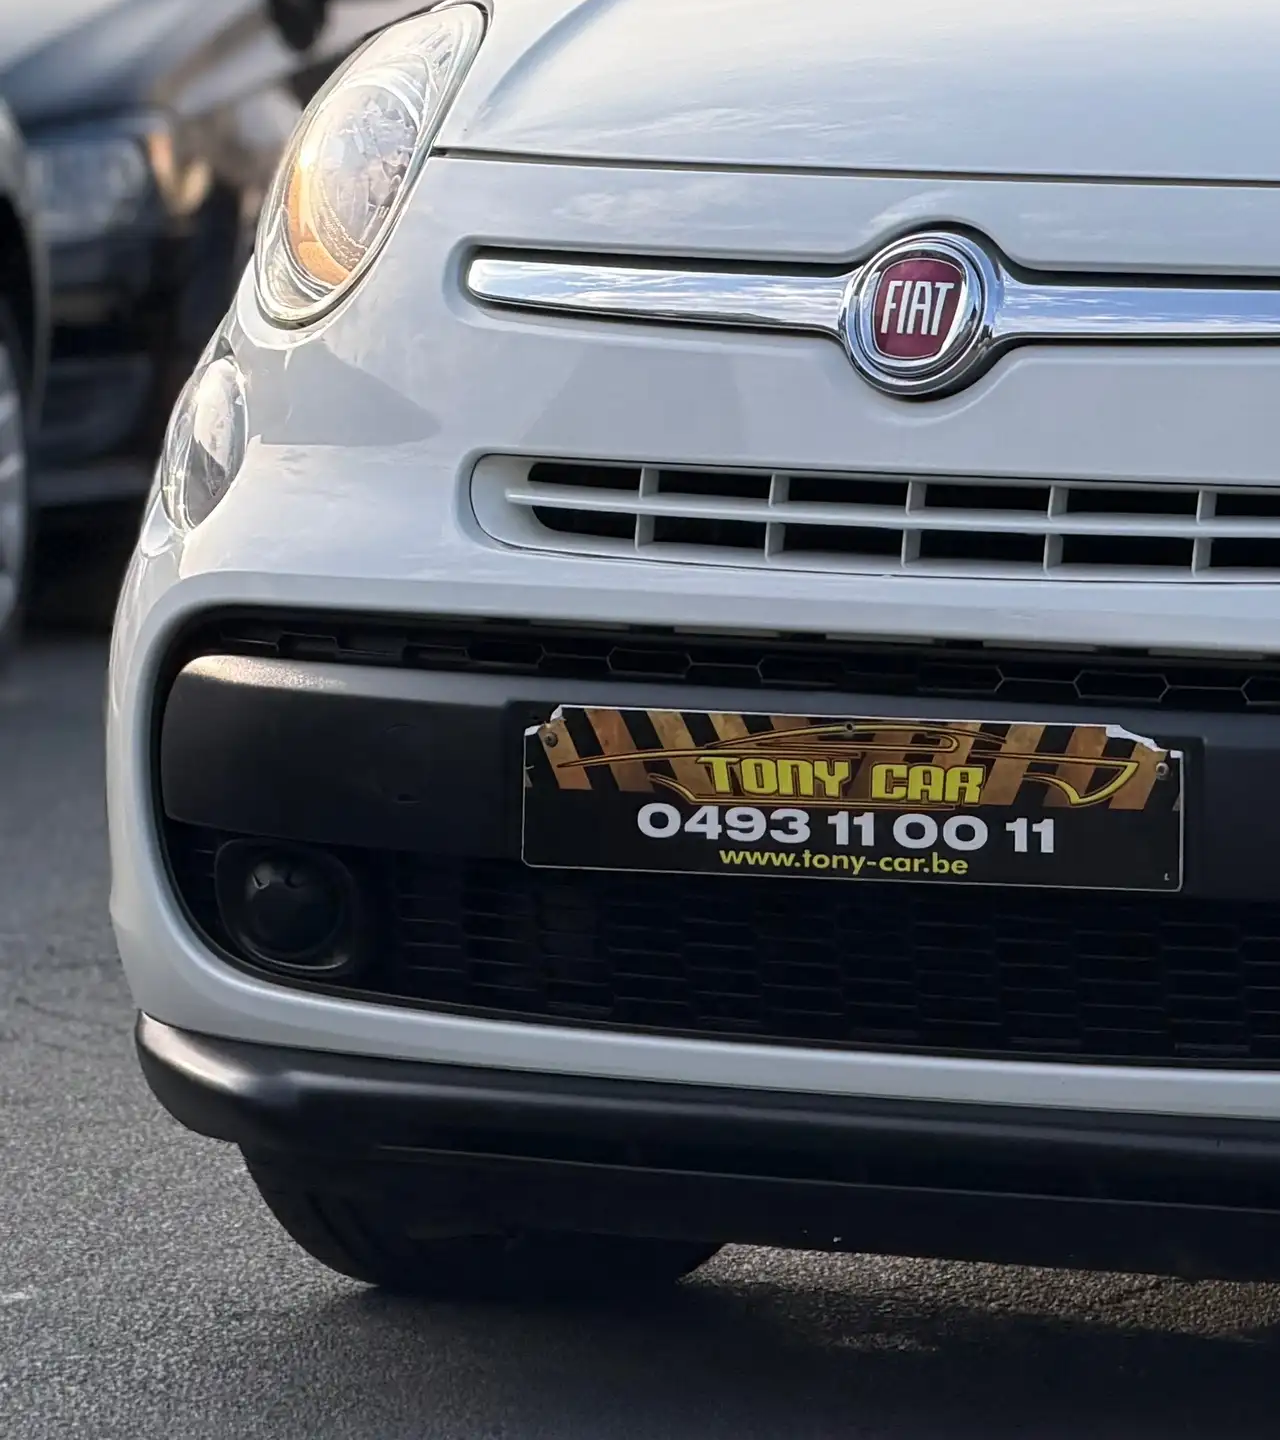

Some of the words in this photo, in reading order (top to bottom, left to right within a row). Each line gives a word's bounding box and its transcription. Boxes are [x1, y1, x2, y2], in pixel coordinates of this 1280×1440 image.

[881, 280, 955, 336] FIAT
[698, 756, 849, 798] TONY
[870, 763, 984, 804] CAR
[637, 803, 811, 844] 0493
[827, 810, 875, 847] 11
[892, 812, 989, 852] 00
[1005, 817, 1055, 854] 11
[719, 849, 969, 876] www.tony-car.be
